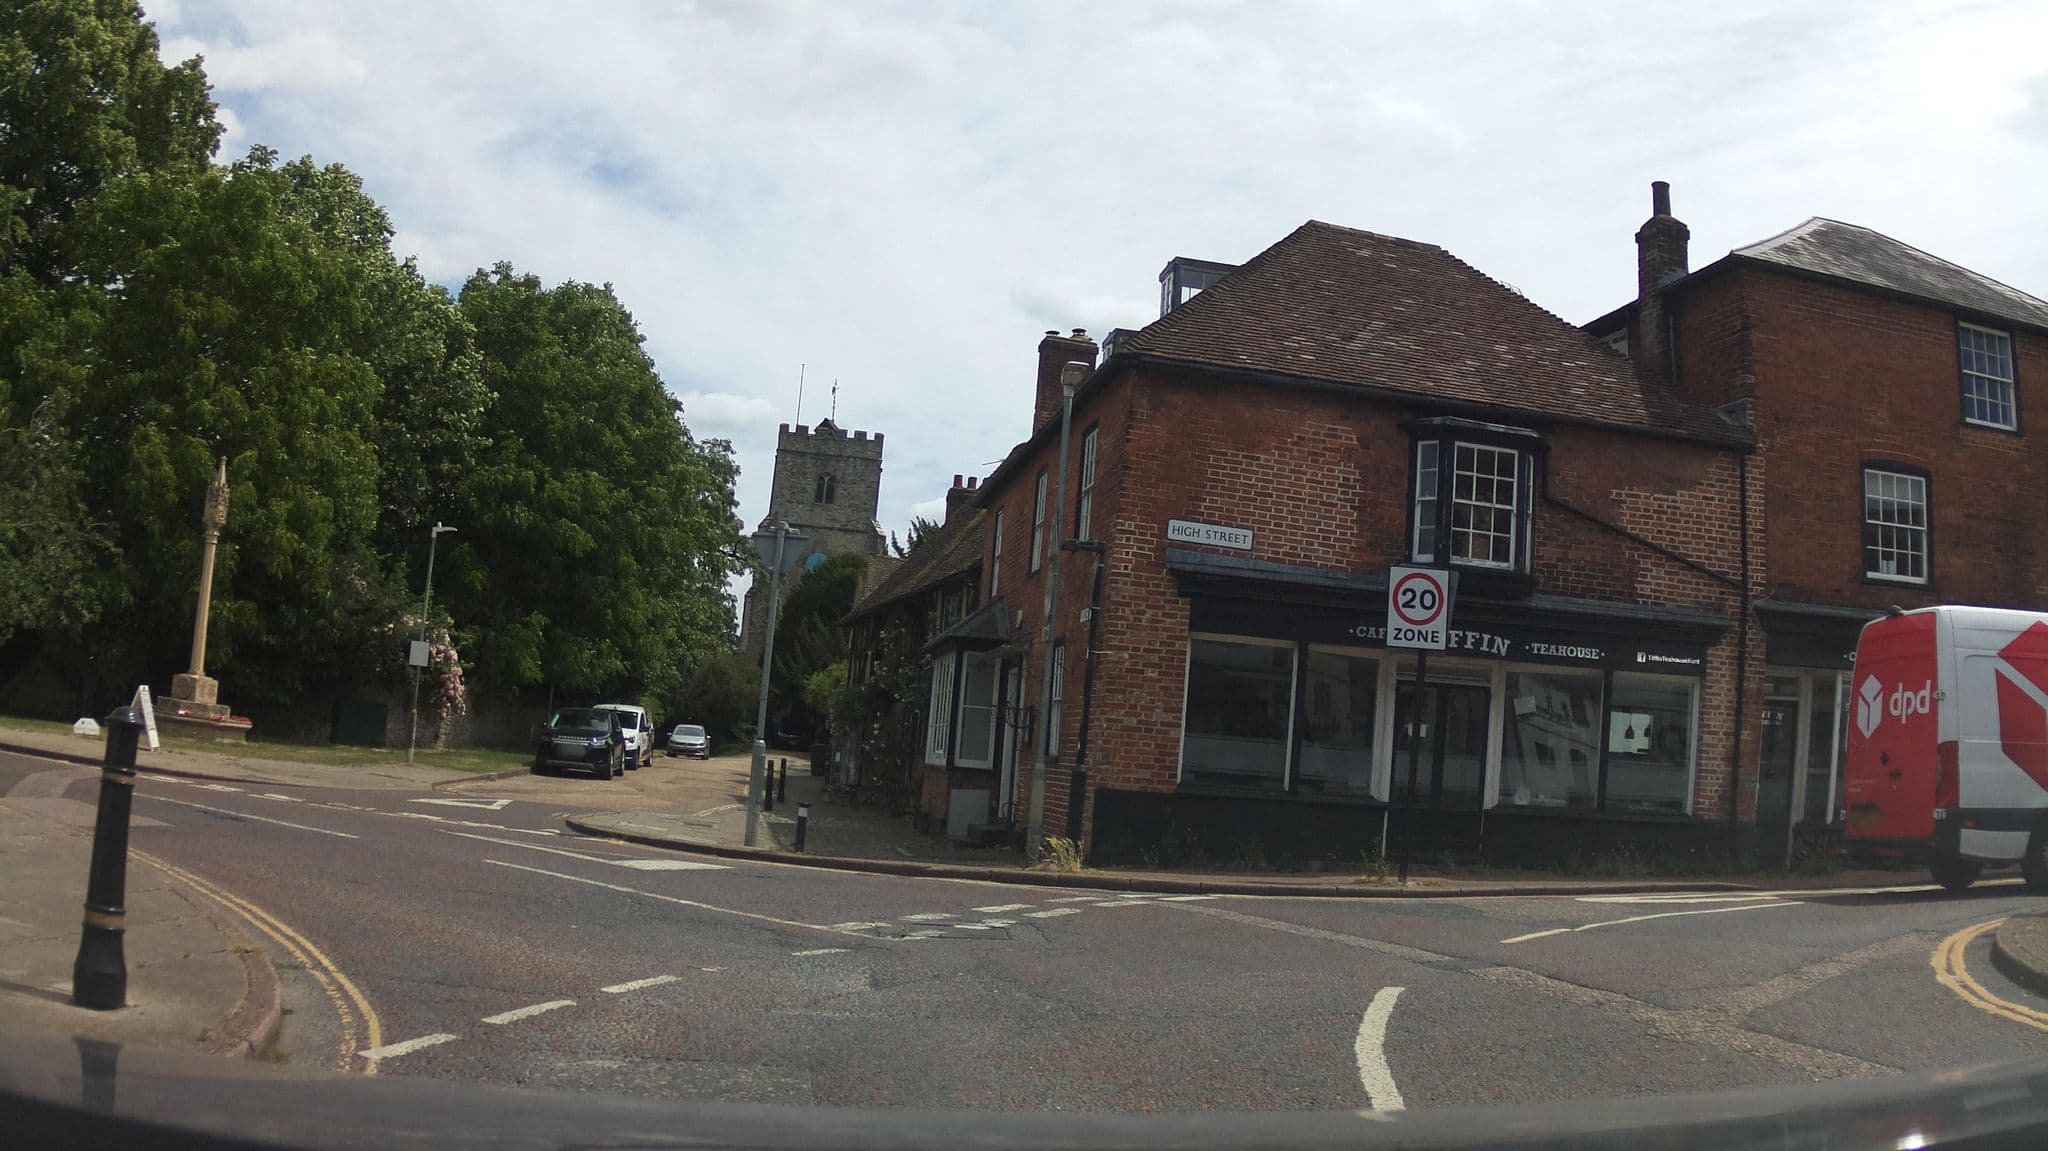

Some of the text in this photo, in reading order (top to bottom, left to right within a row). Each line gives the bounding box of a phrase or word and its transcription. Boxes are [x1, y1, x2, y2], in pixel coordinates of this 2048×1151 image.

[1172, 525, 1249, 545] HIGH STREET
[1401, 587, 1437, 611] 20
[1356, 626, 1386, 639] CAF
[1393, 628, 1440, 643] ZONE
[1449, 630, 1511, 657] FFIN
[1531, 642, 1600, 660] TEAHOUSE
[1889, 680, 1931, 724] dpd
